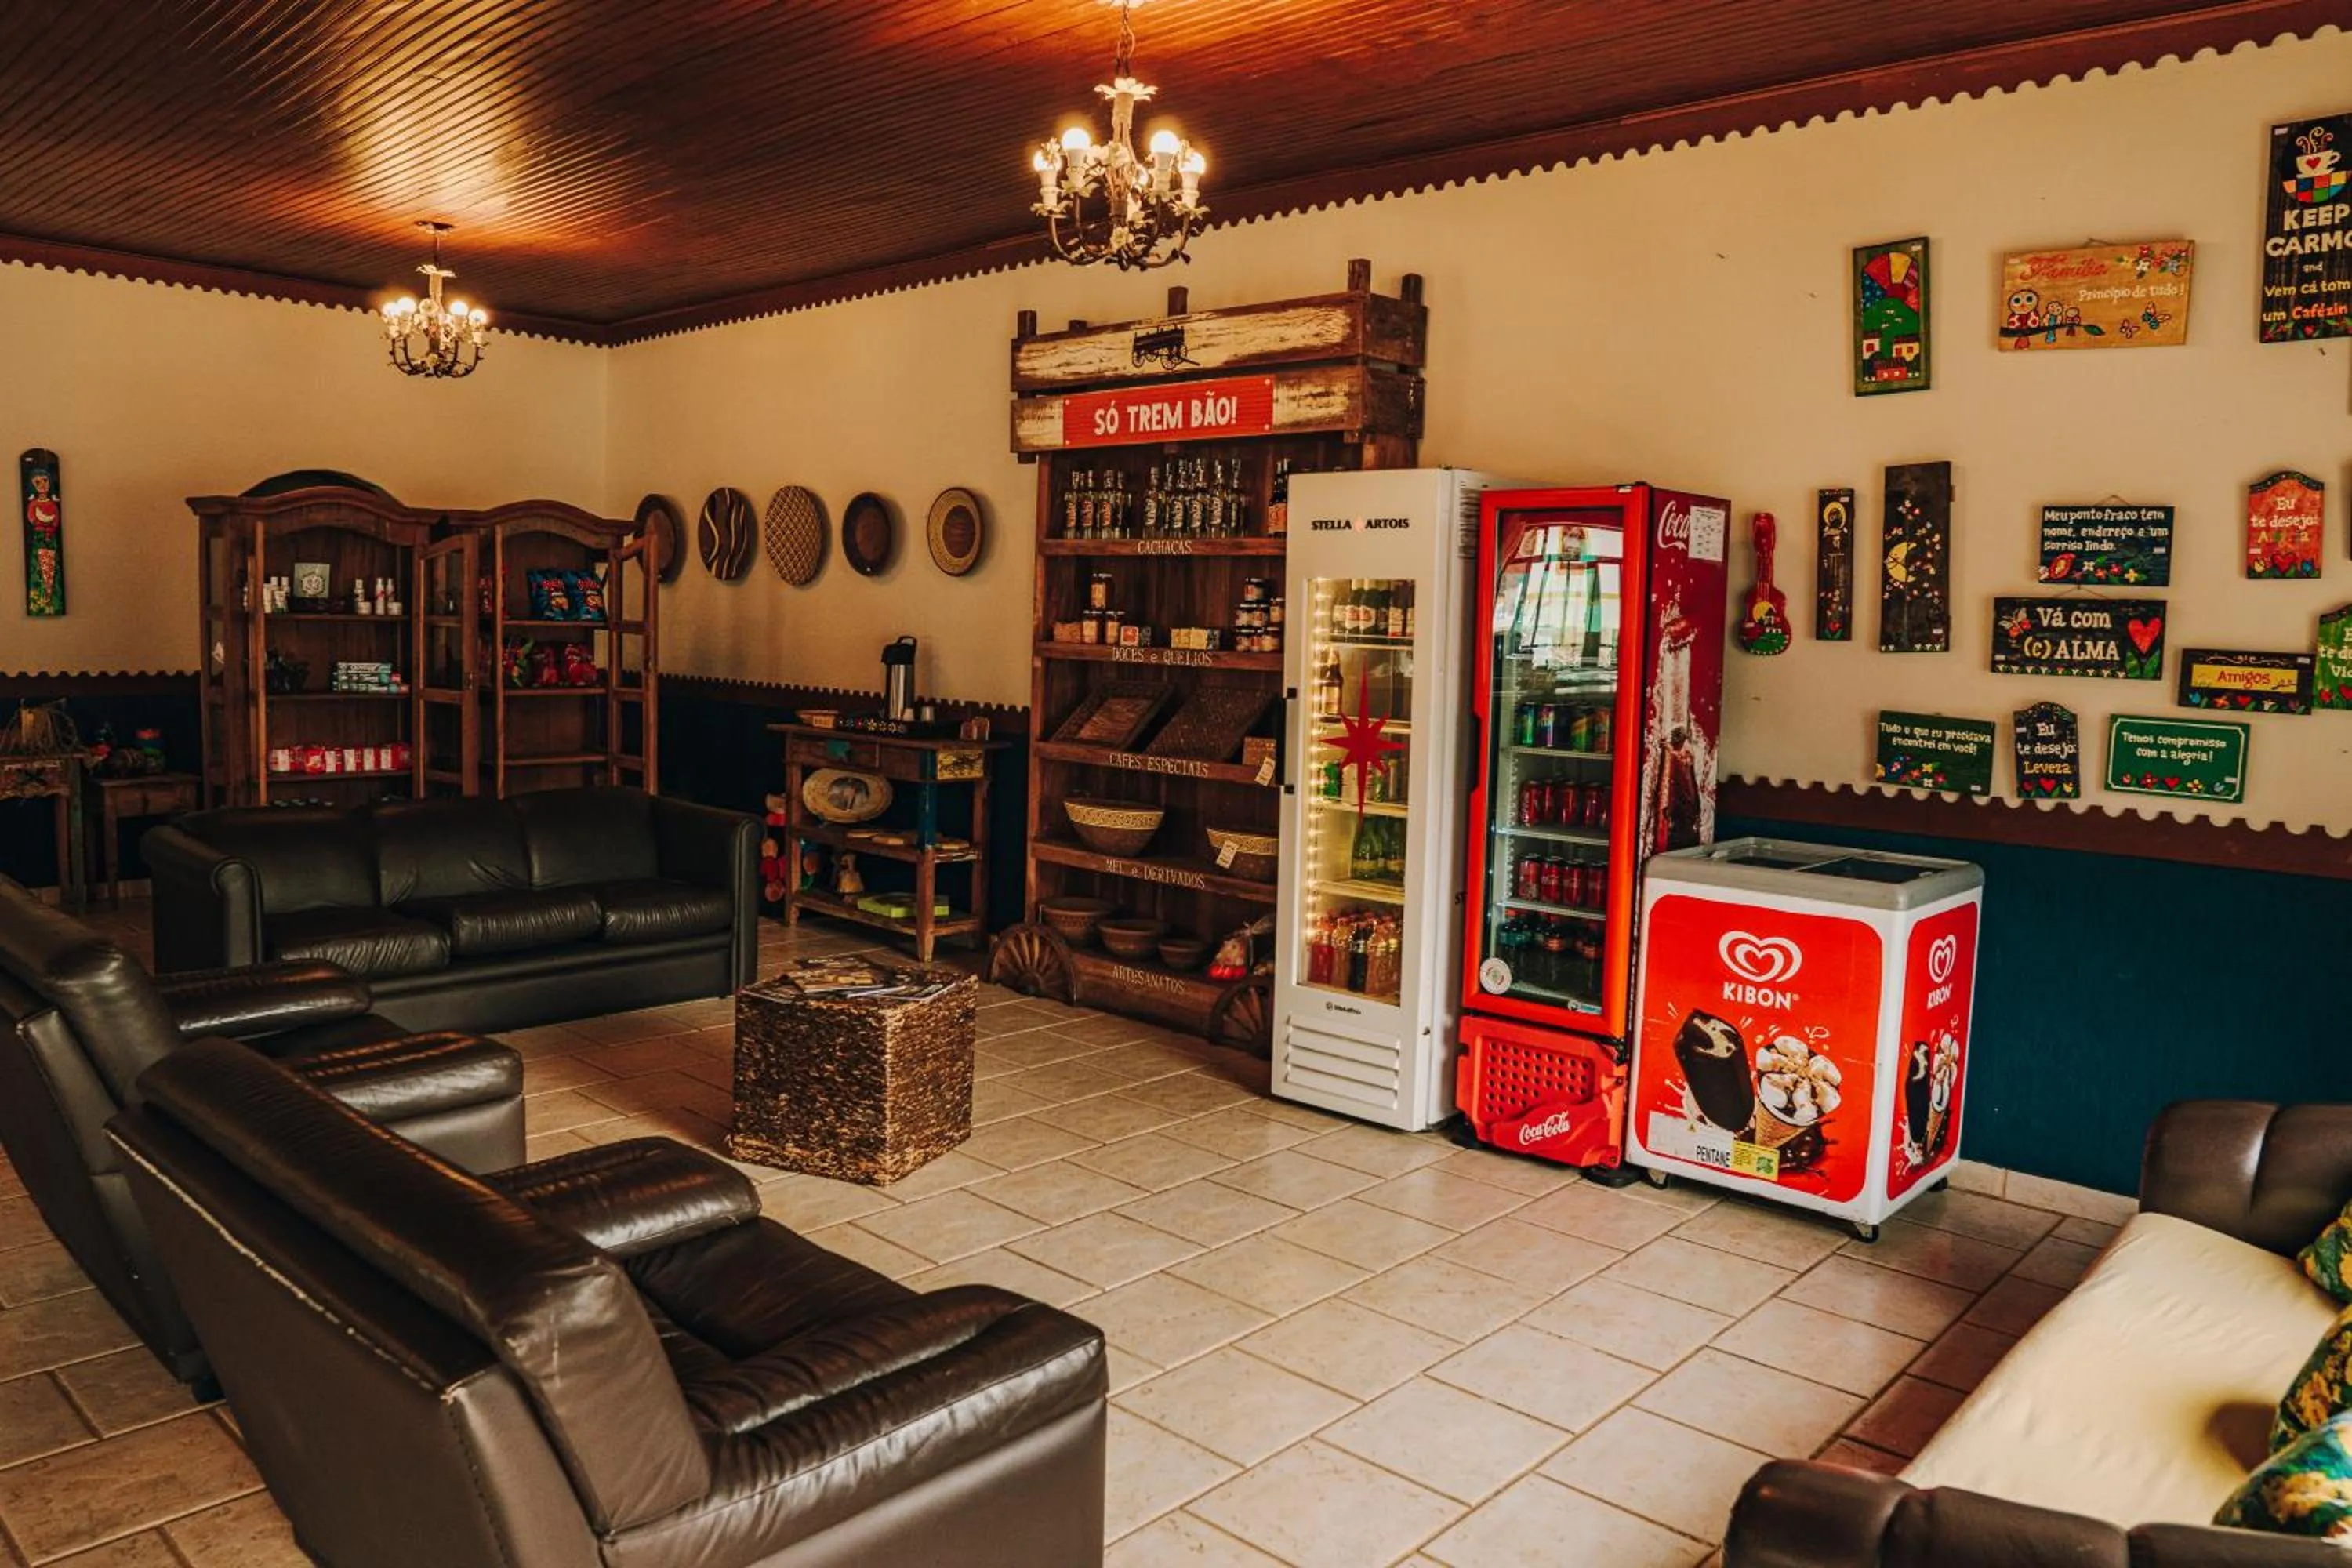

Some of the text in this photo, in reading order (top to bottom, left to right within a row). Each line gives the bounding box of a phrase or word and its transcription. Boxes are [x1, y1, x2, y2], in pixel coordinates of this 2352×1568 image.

[2283, 203, 2350, 230] KEEP
[2303, 262, 2324, 273] and
[2132, 287, 2147, 298] de
[2263, 285, 2296, 298] Vem
[2301, 281, 2318, 295] cá
[2263, 309, 2287, 322] um
[1093, 390, 1238, 435] SÓ TREM BÃO!
[2276, 497, 2296, 510] Eu
[1312, 518, 1410, 531] STELLA ARTOIS
[2044, 508, 2165, 524] Meu ponto fraco tem
[2250, 514, 2267, 528] te
[2080, 525, 2134, 540] endereço
[2138, 528, 2144, 537] e
[2149, 527, 2169, 537] um
[2044, 540, 2083, 551] sorriso
[2036, 607, 2112, 628] Vá com
[1112, 648, 1213, 666] DOCES e QUEIJOS
[2217, 670, 2271, 689] Amigos
[1879, 722, 1992, 744] Tudo o que eu precisava
[2036, 722, 2055, 736] Eu
[1892, 736, 1936, 750] encontrei
[1937, 741, 1951, 751] em
[2016, 742, 2030, 754] te
[2121, 731, 2227, 749] Temos compromisso
[2136, 747, 2213, 766] com a alegria!
[1147, 757, 1209, 778] ESPECIAIS
[2024, 760, 2072, 775] Leveza
[1131, 867, 1138, 877] e
[1144, 865, 1206, 889] DERIVADOS
[1112, 965, 1186, 995] ARTESANATOS
[1722, 981, 1792, 1011] KIBON
[1927, 982, 1953, 1011] KIBON
[1696, 1145, 1731, 1167] PENTANE
